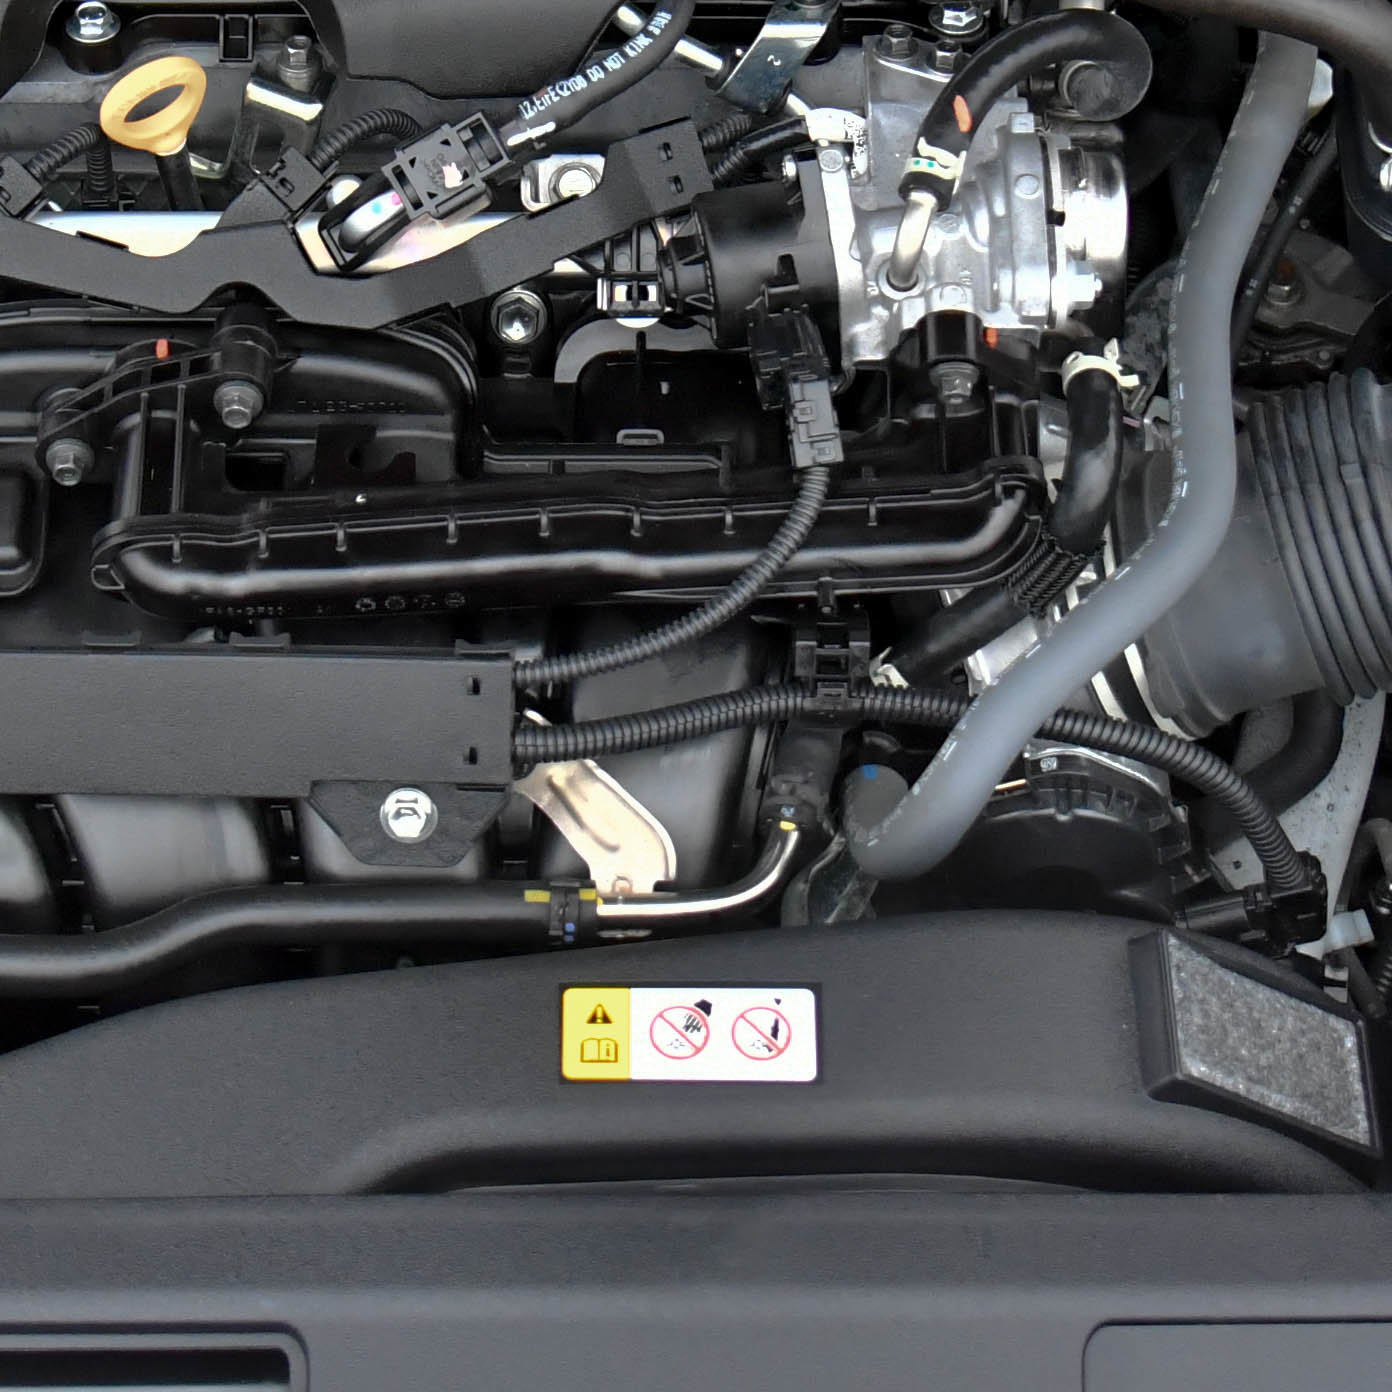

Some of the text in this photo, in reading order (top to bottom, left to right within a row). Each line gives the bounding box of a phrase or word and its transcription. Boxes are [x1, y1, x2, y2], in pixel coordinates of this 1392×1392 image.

[586, 65, 605, 82] DO
[603, 52, 626, 71] NOT
[623, 32, 653, 57] KINK
